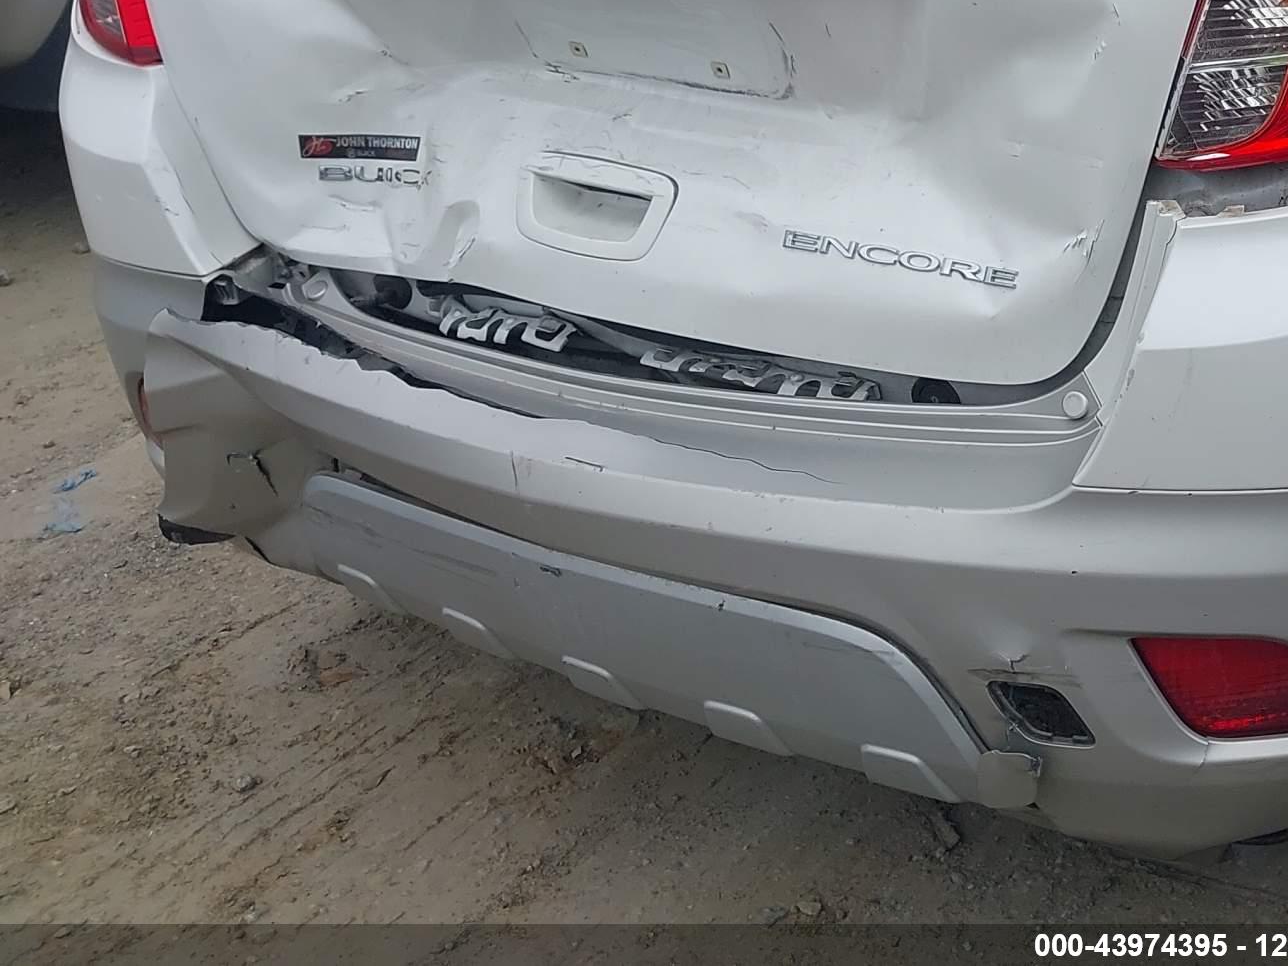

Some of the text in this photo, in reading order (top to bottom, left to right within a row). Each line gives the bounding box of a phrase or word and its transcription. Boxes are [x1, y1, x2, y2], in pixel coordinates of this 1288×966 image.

[336, 136, 365, 148] JOHN
[367, 137, 418, 149] THORNTON
[782, 229, 1019, 289] ENCORE
